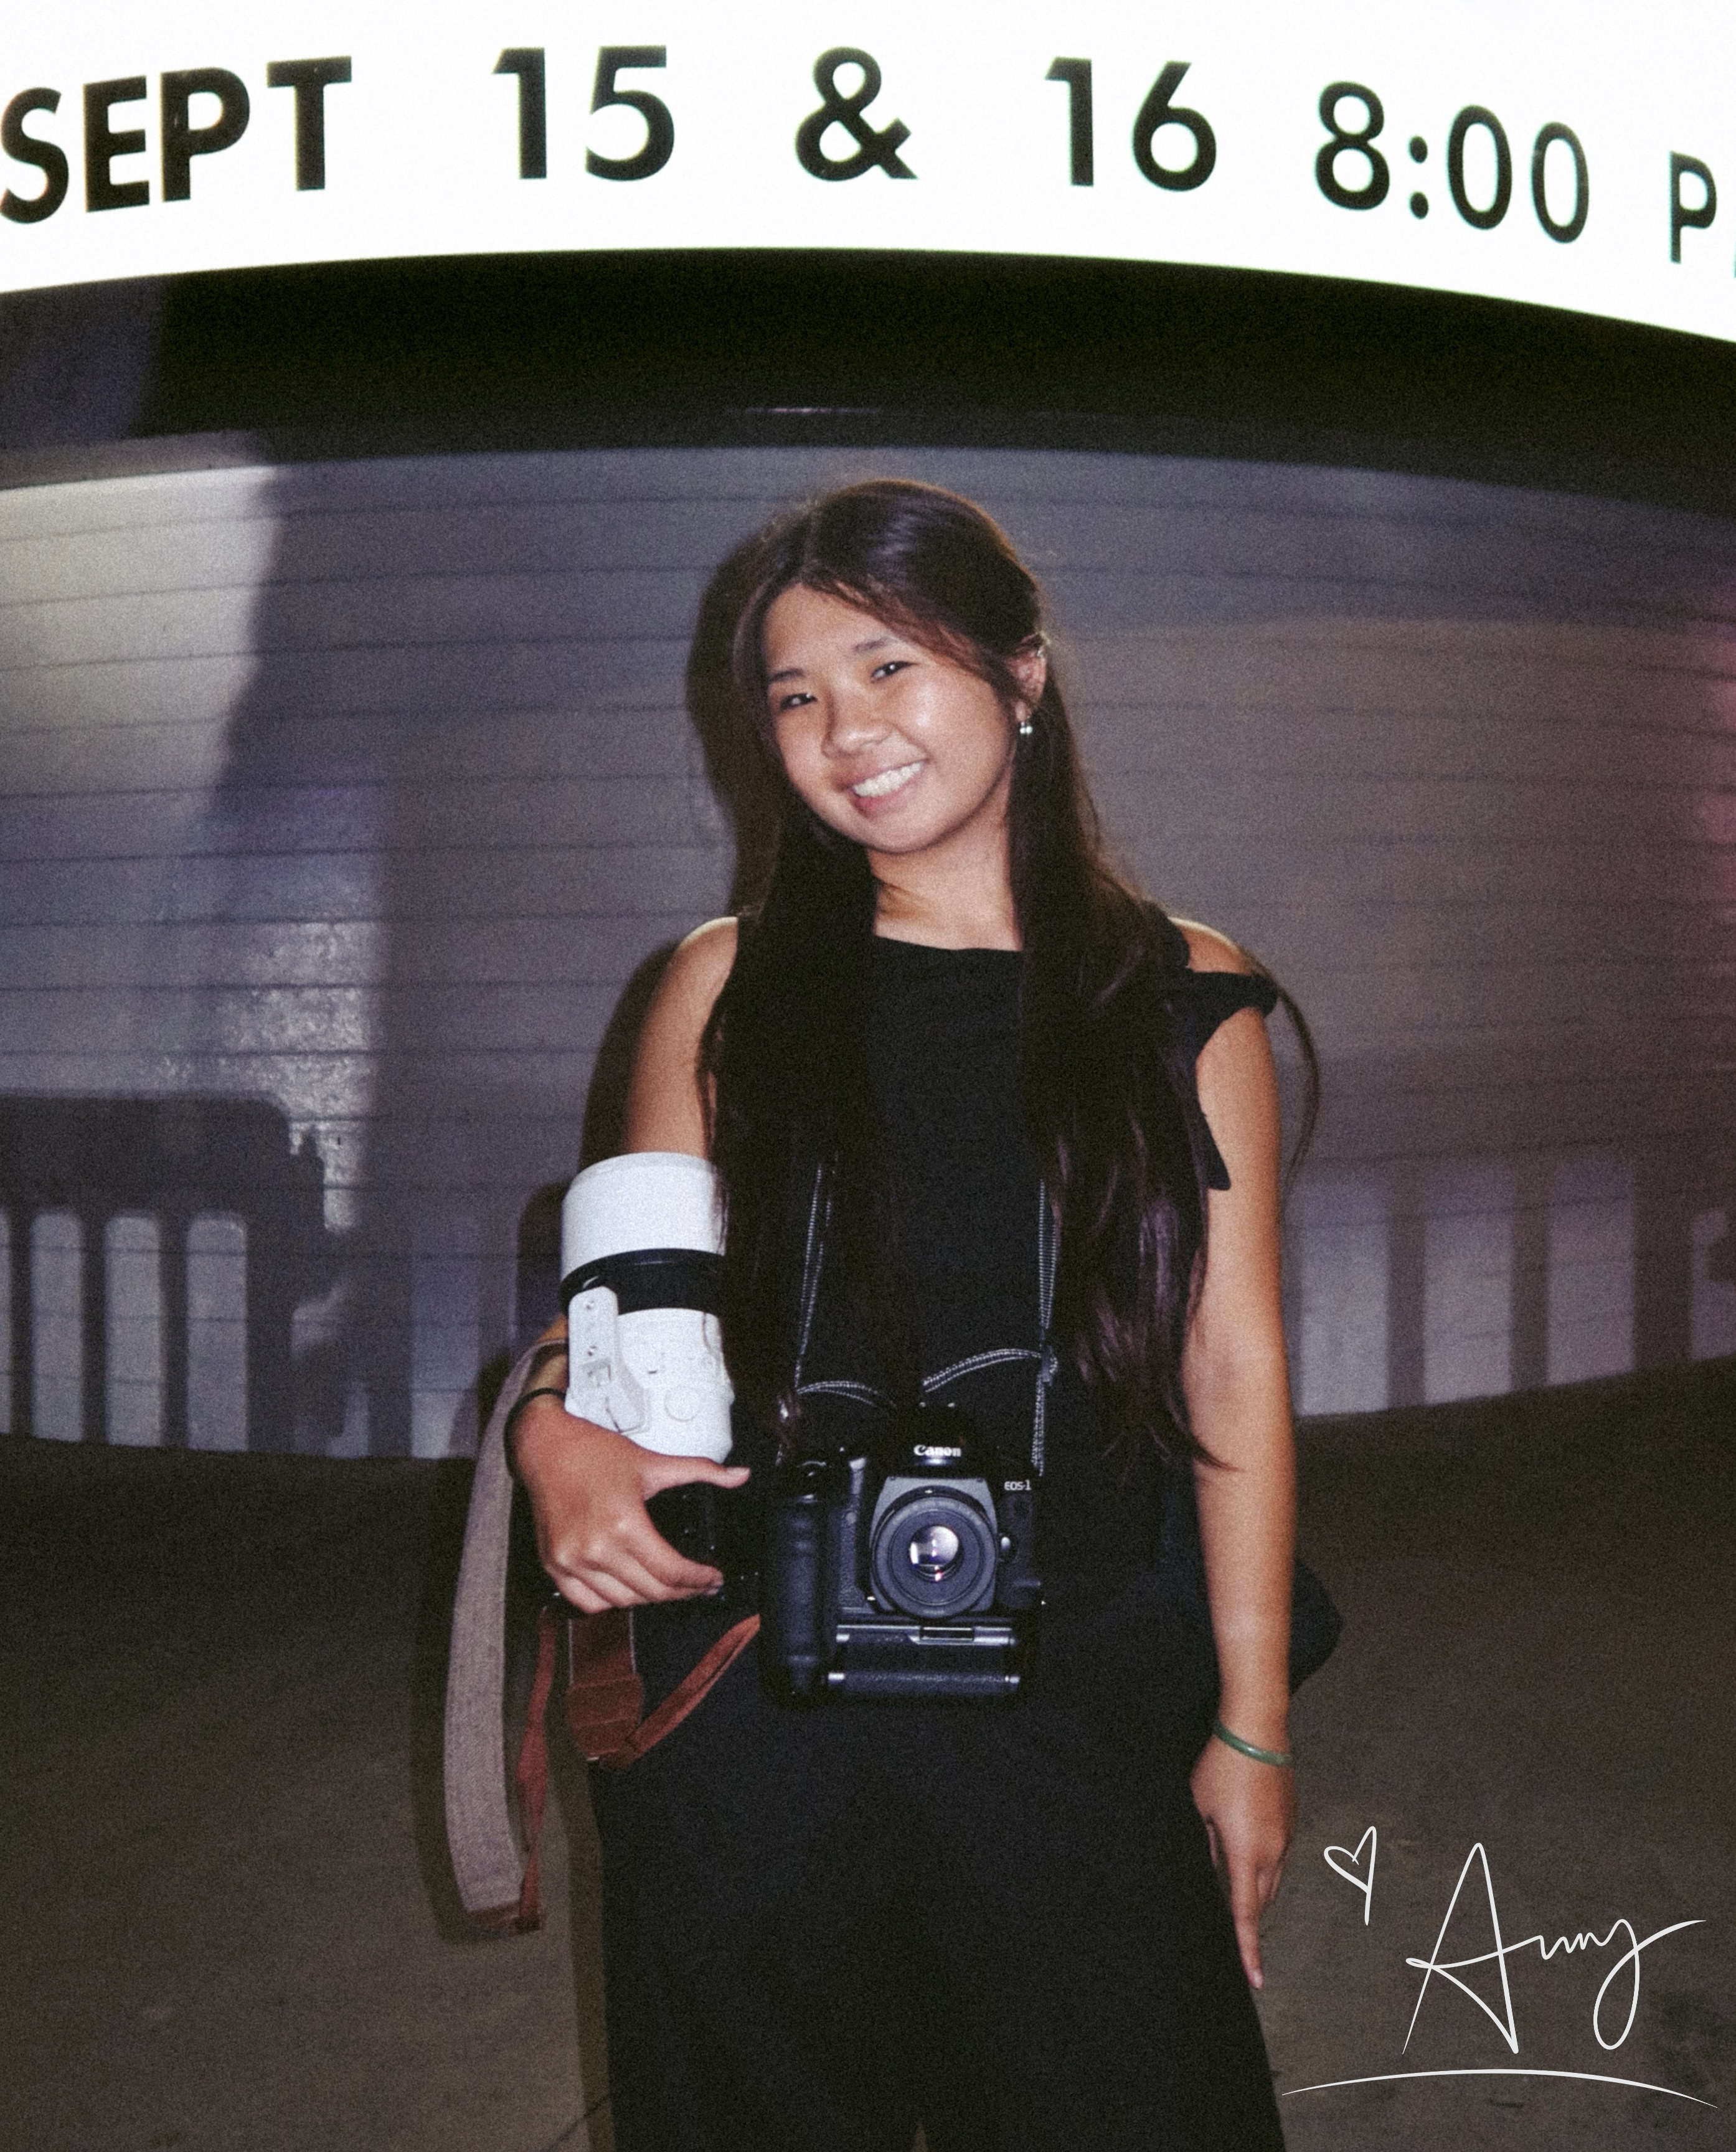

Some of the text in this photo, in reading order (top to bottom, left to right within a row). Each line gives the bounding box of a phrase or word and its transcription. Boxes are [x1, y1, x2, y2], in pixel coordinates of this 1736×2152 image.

[0, 47, 1736, 278] SEPT 15 & 16 8:00 P
[913, 1444, 961, 1457] Canon
